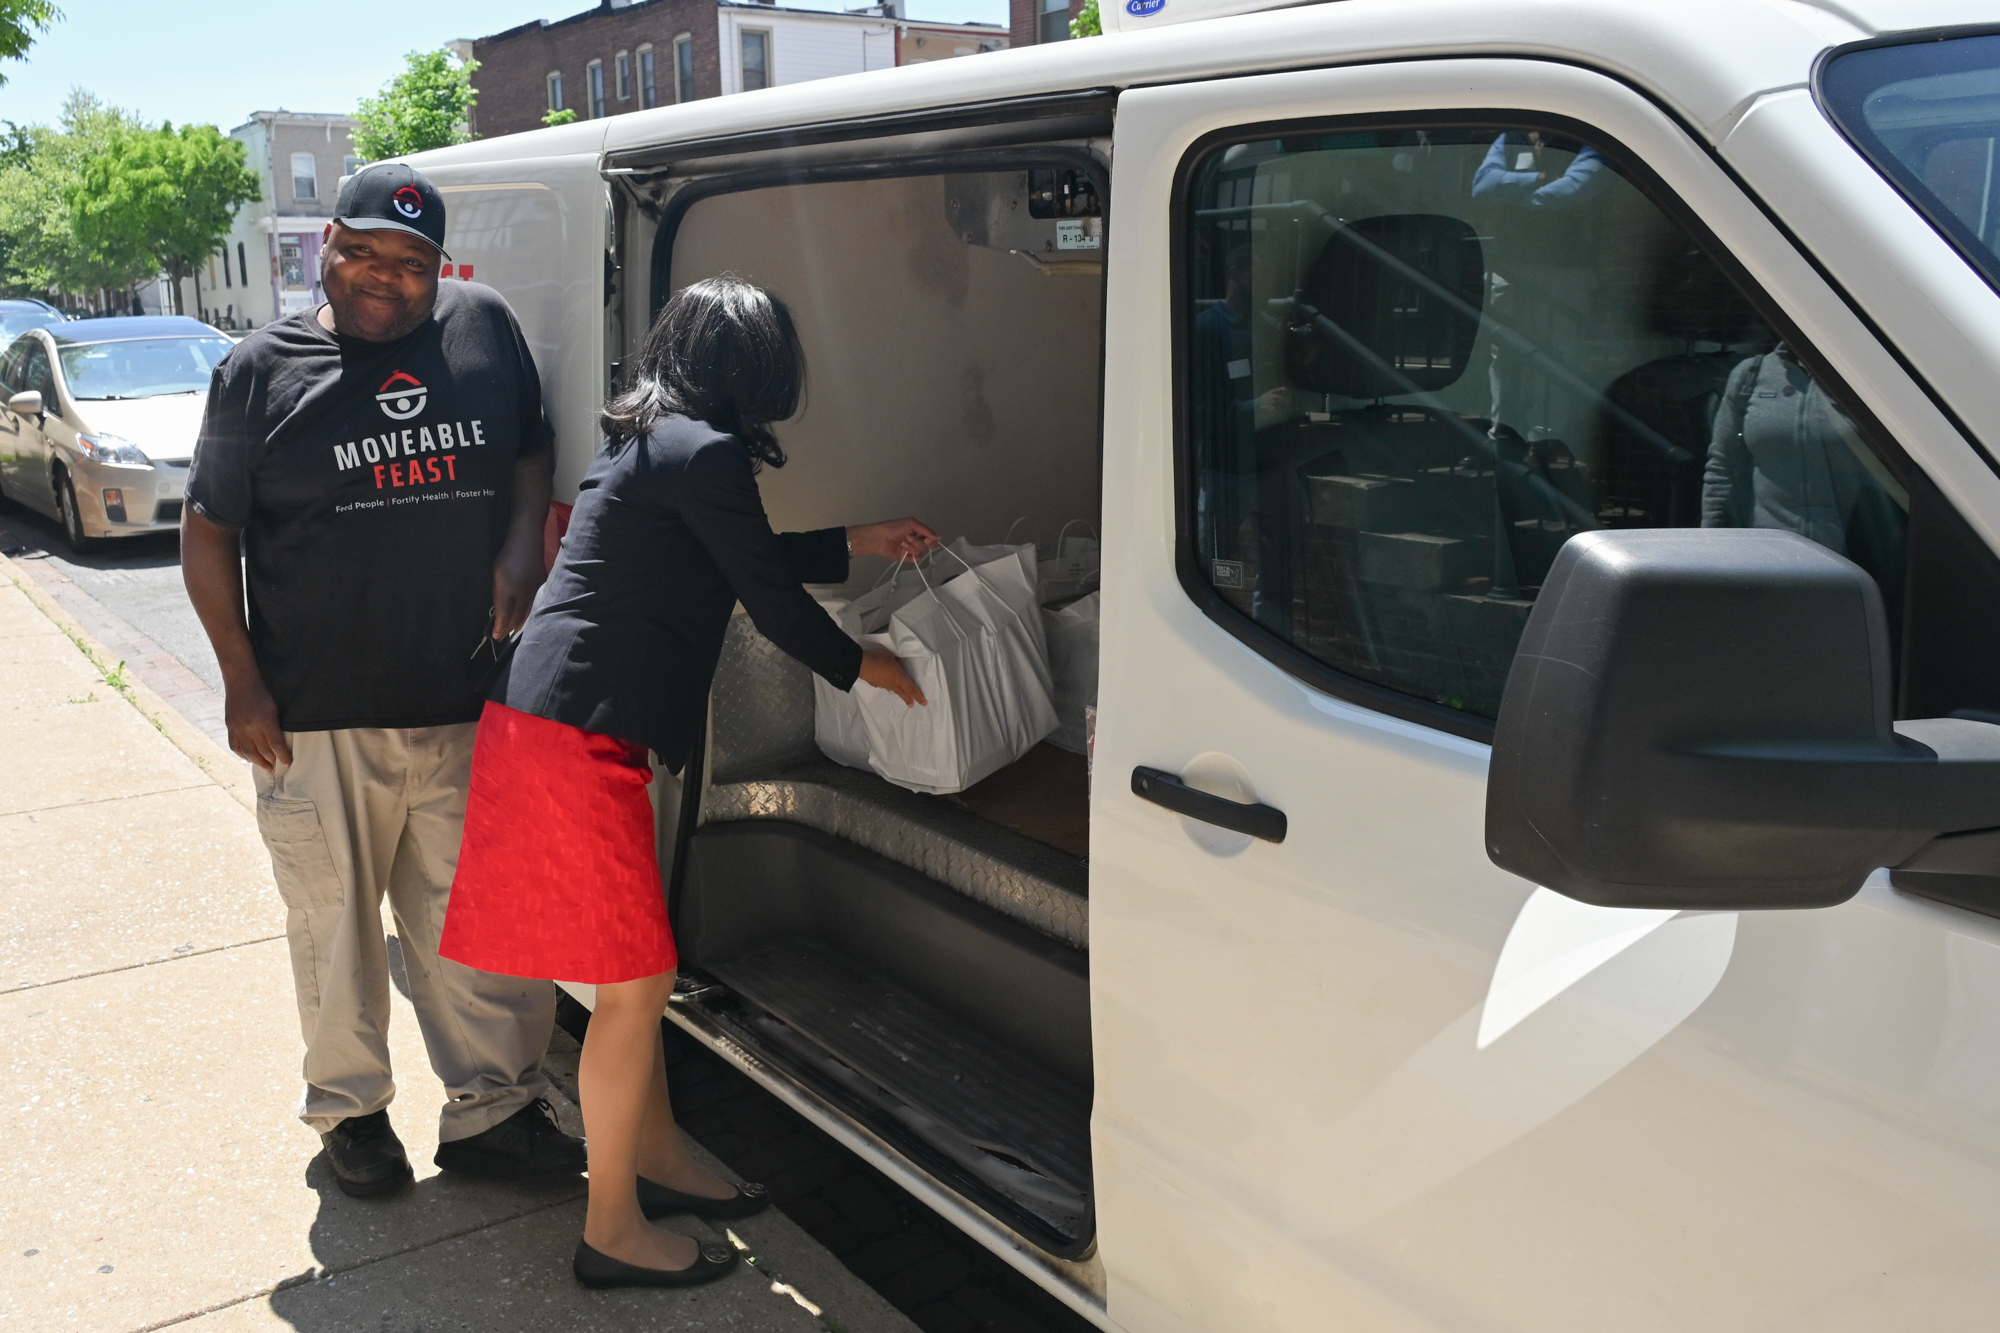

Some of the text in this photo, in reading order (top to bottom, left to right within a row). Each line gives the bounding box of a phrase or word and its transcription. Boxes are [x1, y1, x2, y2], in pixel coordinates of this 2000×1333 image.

[333, 420, 486, 471] MOVEABLE
[373, 455, 457, 489] FEAST
[335, 502, 353, 514] Feed
[355, 499, 385, 510] People
[391, 495, 420, 507] Fortify
[422, 491, 449, 502] Health
[456, 488, 481, 499] Foster
